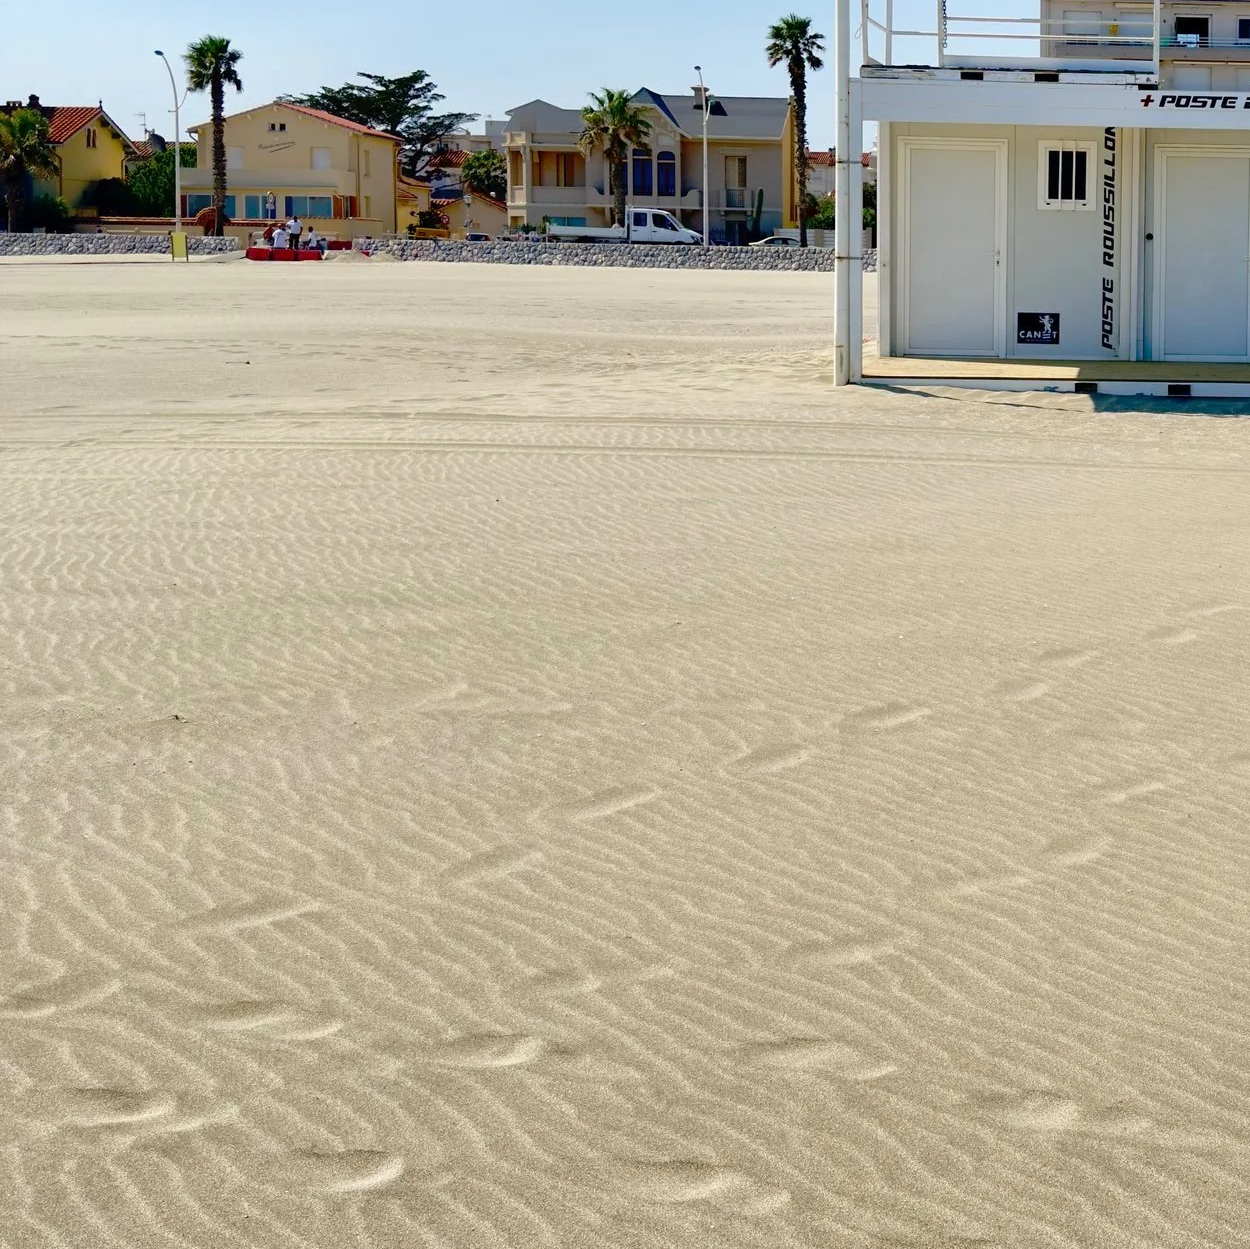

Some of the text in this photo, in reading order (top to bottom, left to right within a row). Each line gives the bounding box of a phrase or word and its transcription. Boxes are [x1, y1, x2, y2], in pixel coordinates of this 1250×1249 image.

[1158, 94, 1238, 109] POSTE
[1102, 277, 1114, 350] POSTE
[1019, 330, 1057, 339] CANET
